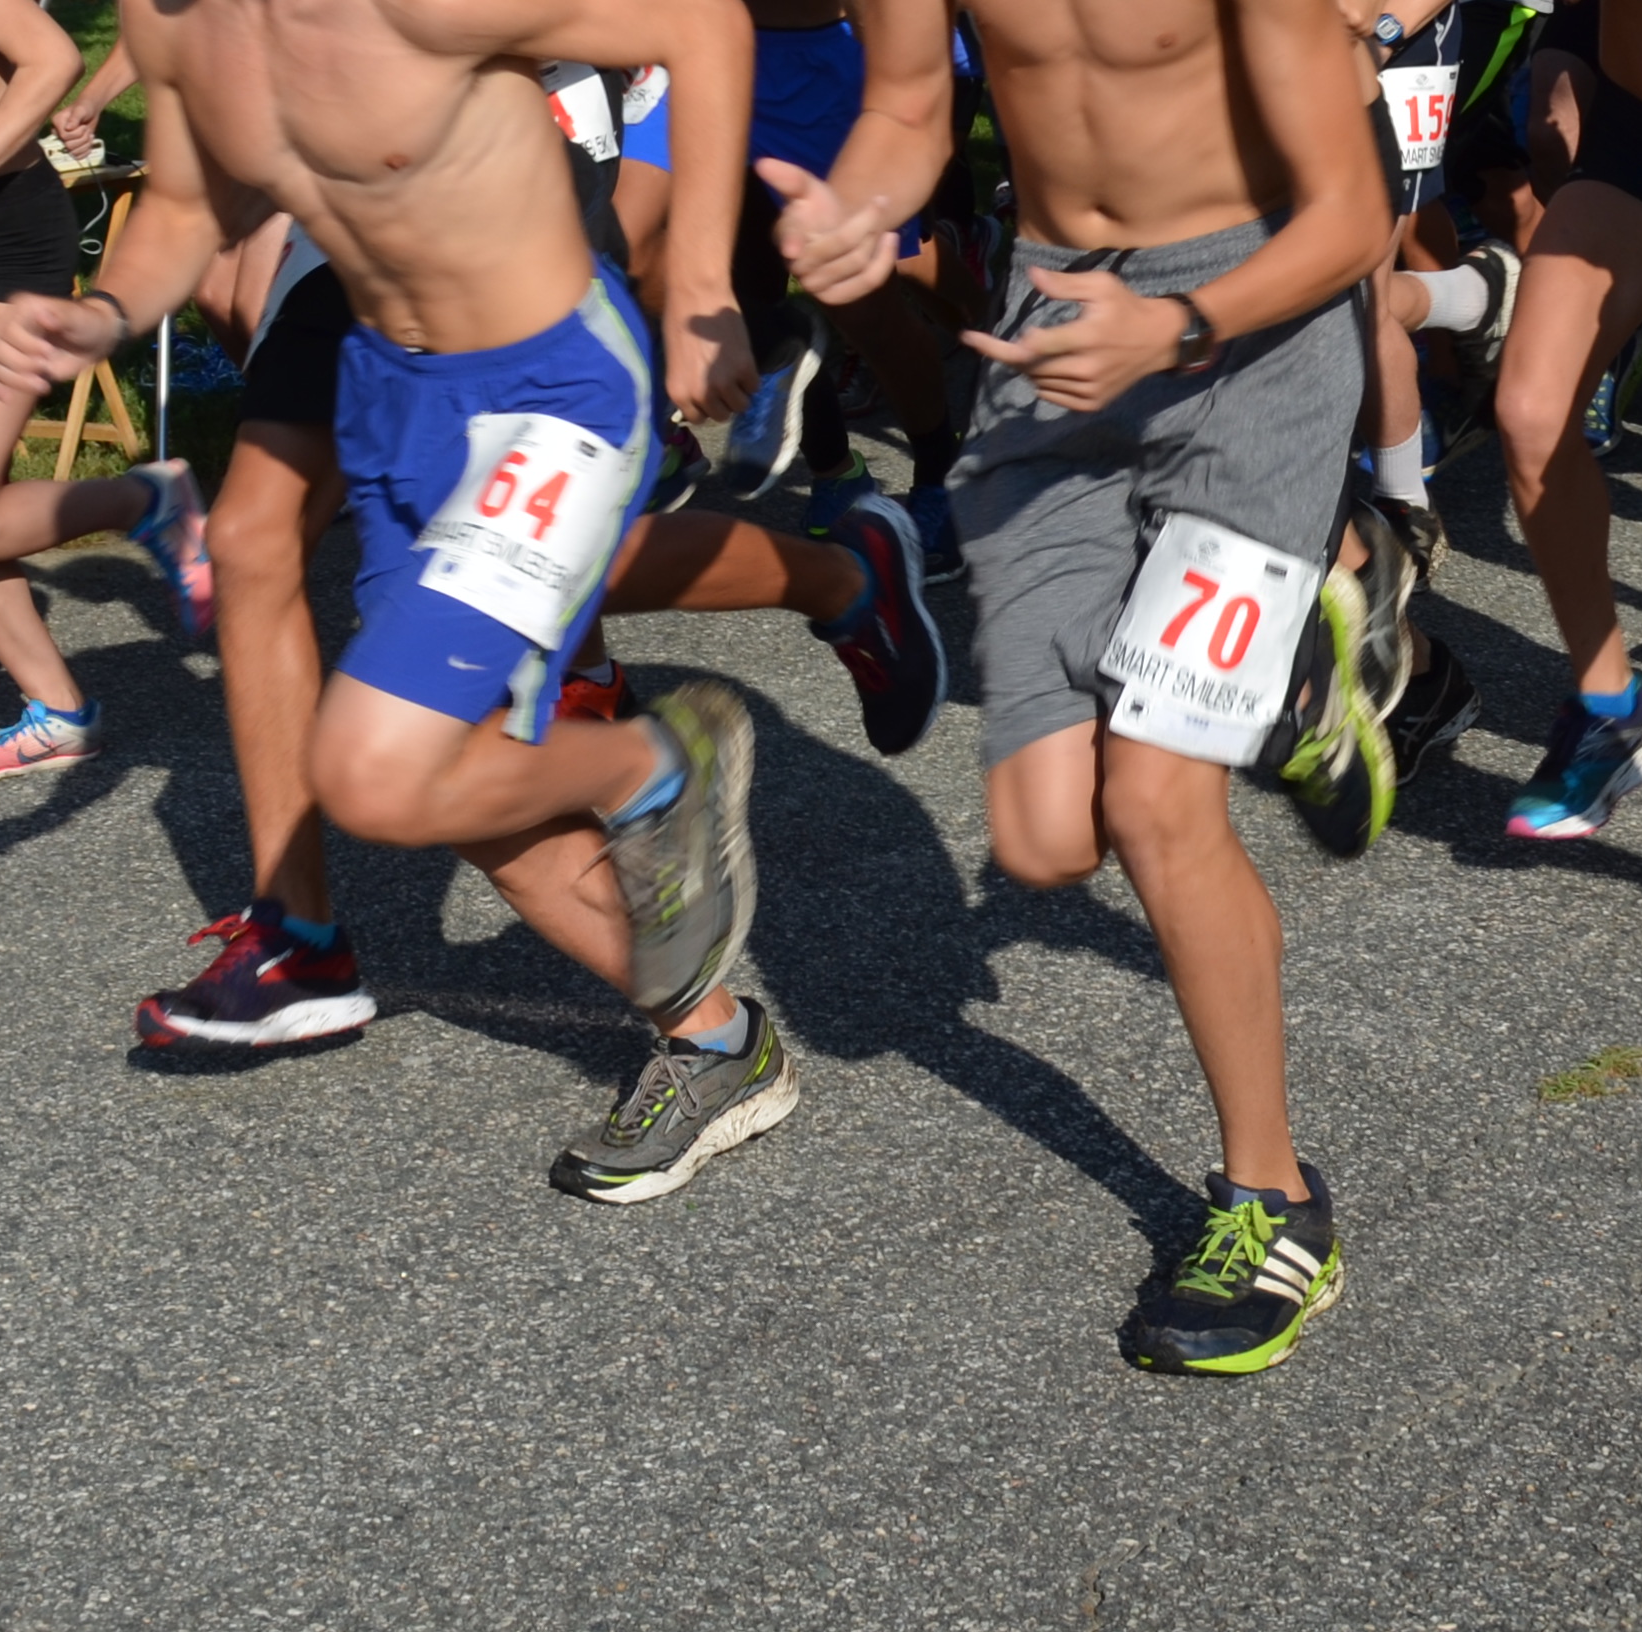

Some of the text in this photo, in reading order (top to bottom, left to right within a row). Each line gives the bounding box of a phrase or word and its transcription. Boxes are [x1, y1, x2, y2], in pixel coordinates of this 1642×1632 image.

[1401, 146, 1429, 165] MART
[474, 450, 575, 542] 64
[1159, 567, 1262, 672] 70
[1107, 636, 1174, 692] SMART
[1171, 666, 1239, 717] SMILES
